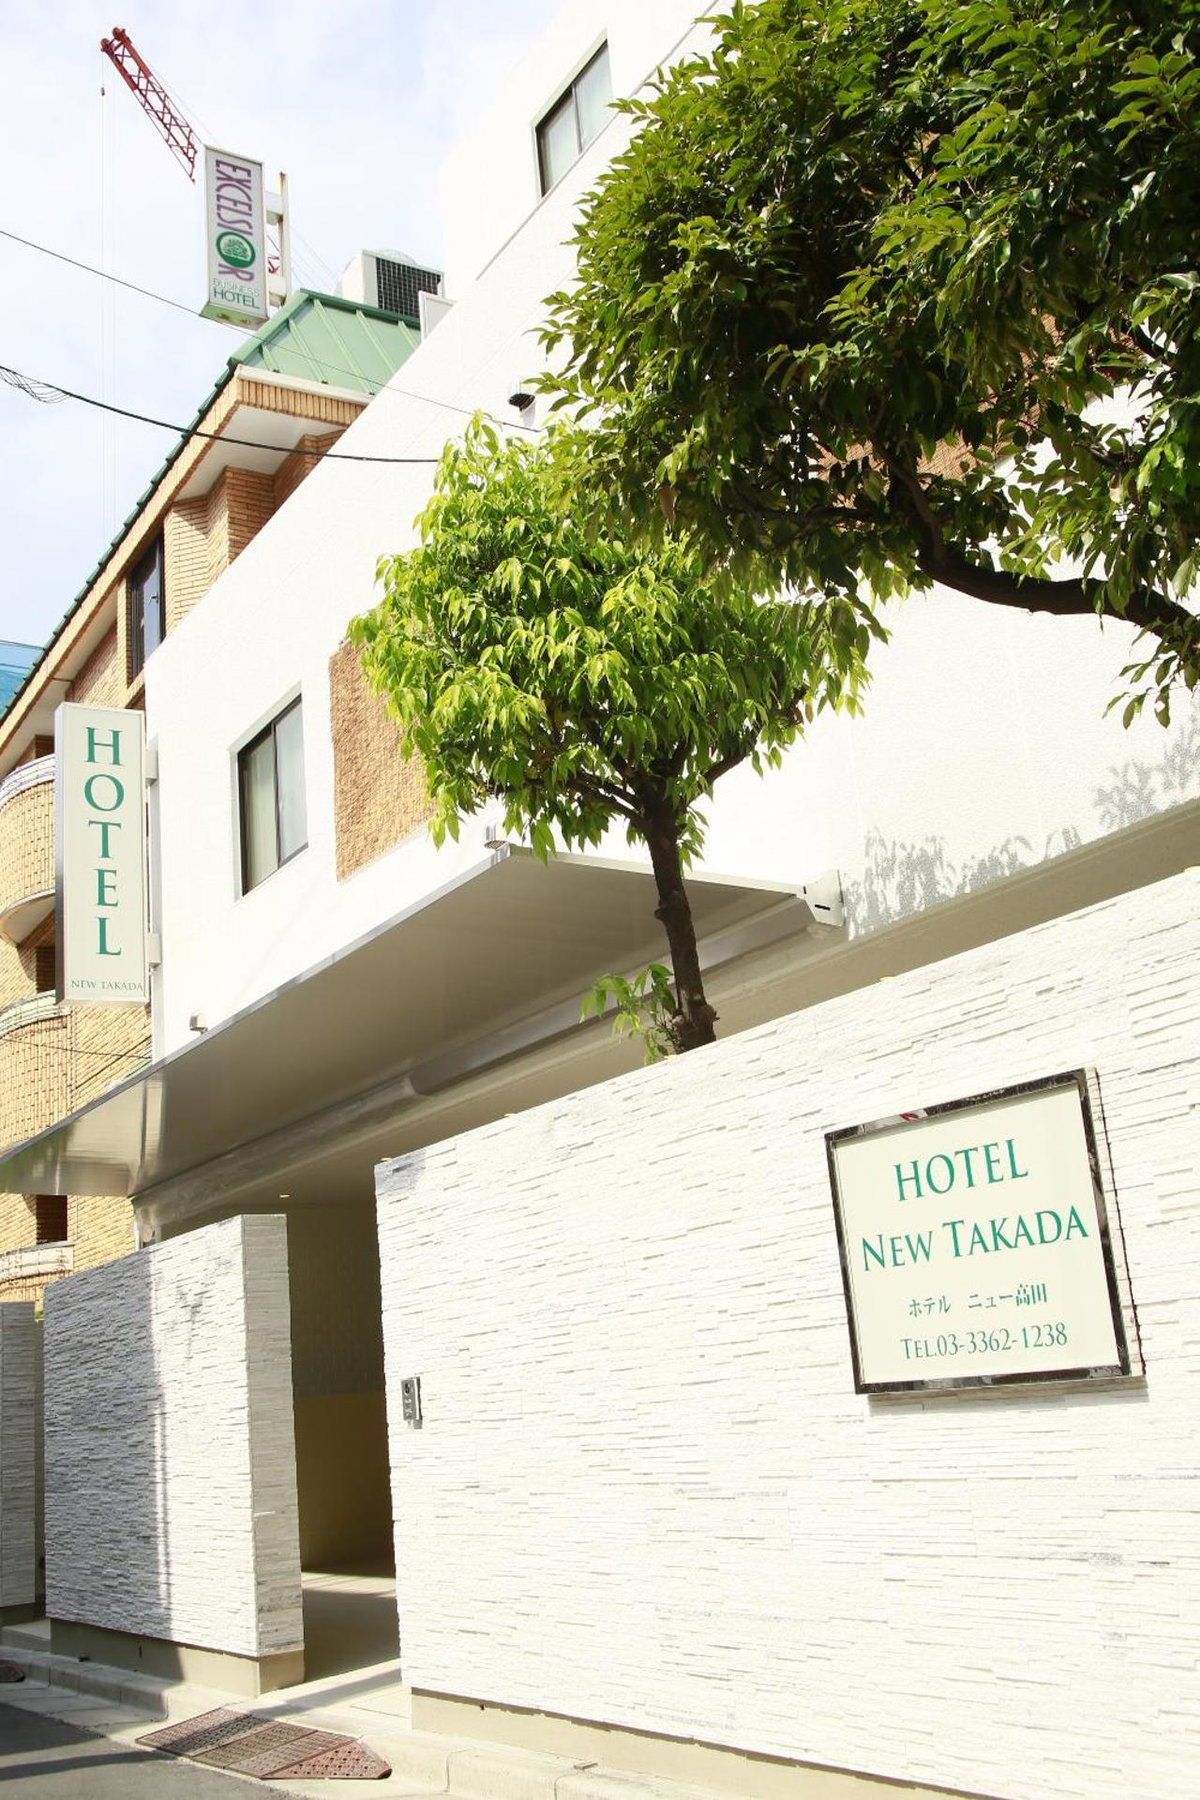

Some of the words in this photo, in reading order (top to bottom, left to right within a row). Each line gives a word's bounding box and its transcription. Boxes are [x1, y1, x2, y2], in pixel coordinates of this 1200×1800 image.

[213, 287, 261, 309] HOTEL
[84, 727, 125, 955] HOTEL
[71, 980, 97, 989] NEW
[100, 981, 144, 991] TAKADA
[893, 1138, 1029, 1202] HOTEL
[862, 1230, 933, 1271] NEW
[942, 1205, 1089, 1258] TAKADA
[909, 1295, 951, 1318] ホテル
